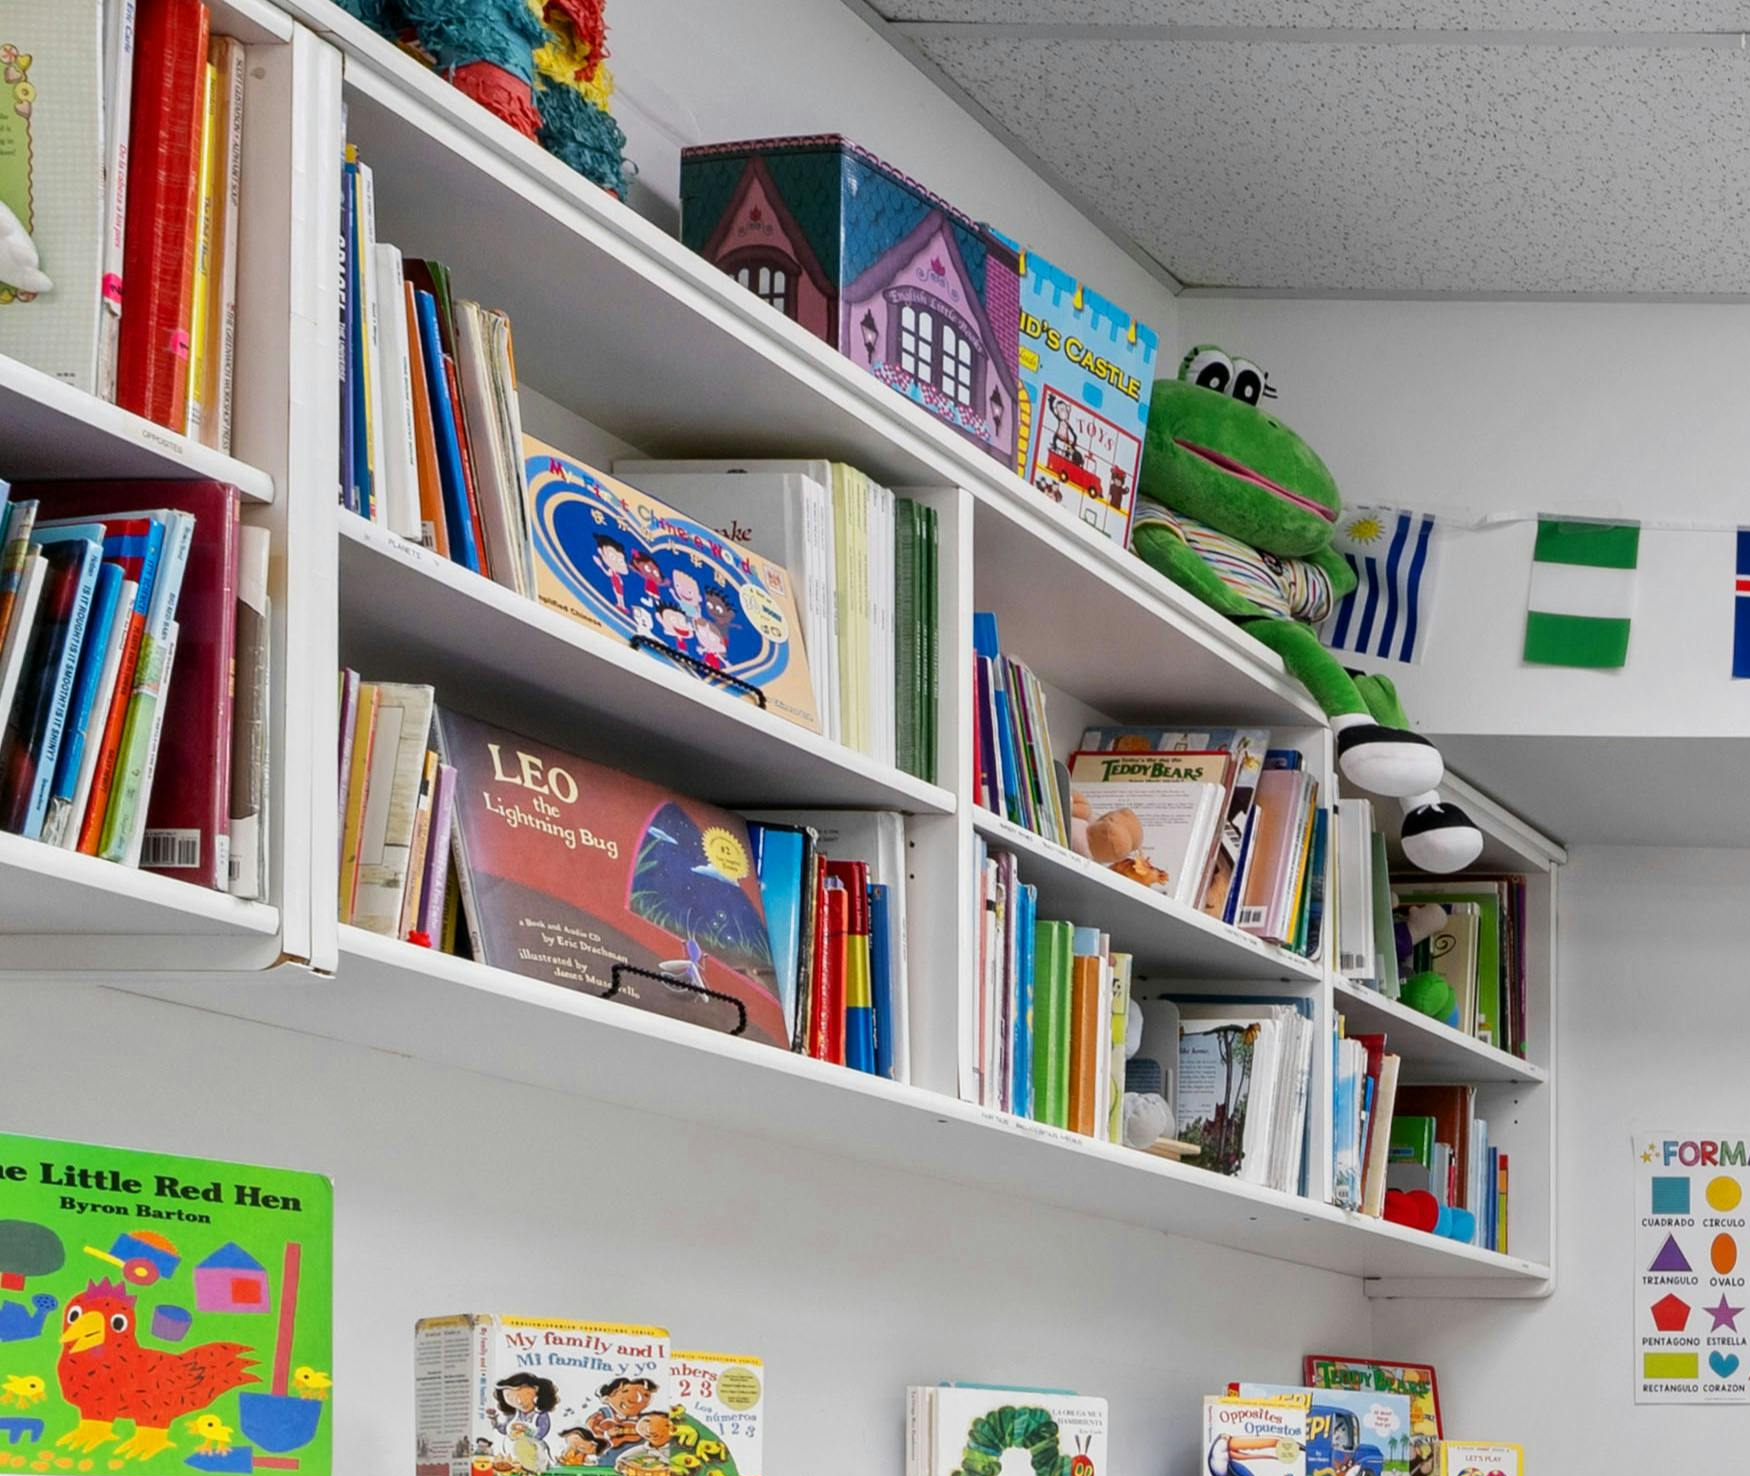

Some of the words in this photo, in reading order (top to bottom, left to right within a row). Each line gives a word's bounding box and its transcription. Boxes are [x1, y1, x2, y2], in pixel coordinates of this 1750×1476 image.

[1020, 312, 1061, 351] ID'S
[1064, 338, 1141, 402] CASTLE
[142, 429, 184, 455] OPPOSITES
[1075, 418, 1115, 452] TOYS
[73, 603, 88, 645] ROUGH?
[59, 664, 76, 710] SMOOTH?
[46, 728, 61, 762] SHINY?
[488, 743, 579, 804] LEO
[1101, 760, 1151, 782] TEDDY
[1151, 763, 1204, 781] BEARS
[533, 796, 560, 818] the
[483, 791, 577, 850] Lightning
[579, 828, 619, 859] Bug
[518, 948, 573, 968] illustrated
[574, 959, 588, 974] by
[541, 933, 555, 946] by
[557, 935, 578, 950] Eric
[579, 941, 629, 964] Drachman
[40, 1162, 143, 1195] Little
[154, 1175, 225, 1204] Red
[234, 1184, 303, 1213] Hen
[59, 1196, 130, 1217] Byron
[135, 1204, 212, 1225] Barton
[1641, 1218, 1696, 1228] CUADRADO
[505, 1332, 538, 1351] My
[544, 1331, 613, 1355] family
[616, 1344, 653, 1358] and
[658, 1344, 665, 1358] I
[1707, 1337, 1747, 1346] ESTRELLA
[516, 1352, 543, 1368] Mi
[547, 1352, 613, 1373] familia
[615, 1361, 630, 1376] y
[634, 1361, 657, 1376] yo
[1315, 1362, 1372, 1388] TEDDY
[679, 1379, 691, 1397] 2
[699, 1380, 712, 1398] 3
[731, 1422, 740, 1435] 2
[745, 1425, 756, 1438] 3
[1218, 1408, 1284, 1426] Opposites
[1244, 1421, 1303, 1438] Opuestos
[1465, 1454, 1483, 1463] LET'S
